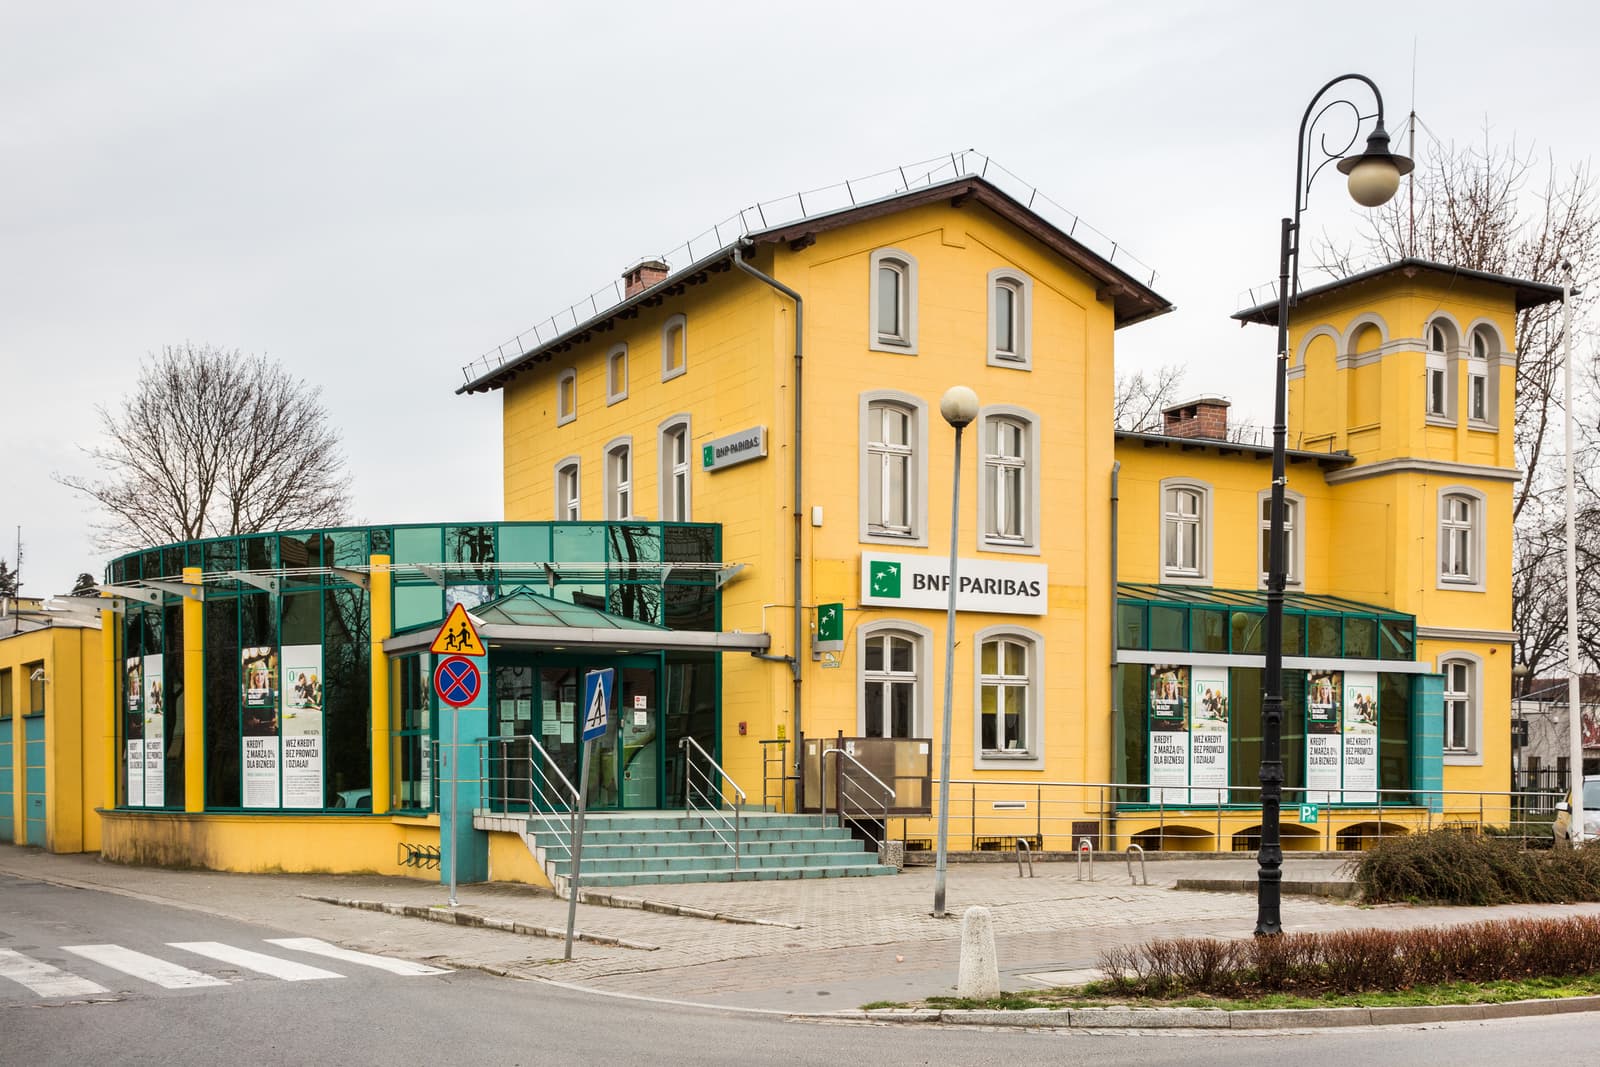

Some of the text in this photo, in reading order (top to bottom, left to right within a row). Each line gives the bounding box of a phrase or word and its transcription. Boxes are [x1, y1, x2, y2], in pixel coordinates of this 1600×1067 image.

[716, 436, 760, 458] BNP PARIBAS
[960, 576, 1040, 597] PARIBAS
[246, 740, 264, 748] KREDYT
[297, 739, 315, 747] KREDYT
[286, 749, 295, 758] BEZ
[246, 760, 275, 768] DLA BIZNESU
[1154, 756, 1184, 764] DLA BIZNESU
[1310, 757, 1318, 765] DLA
[1302, 806, 1311, 822] P
